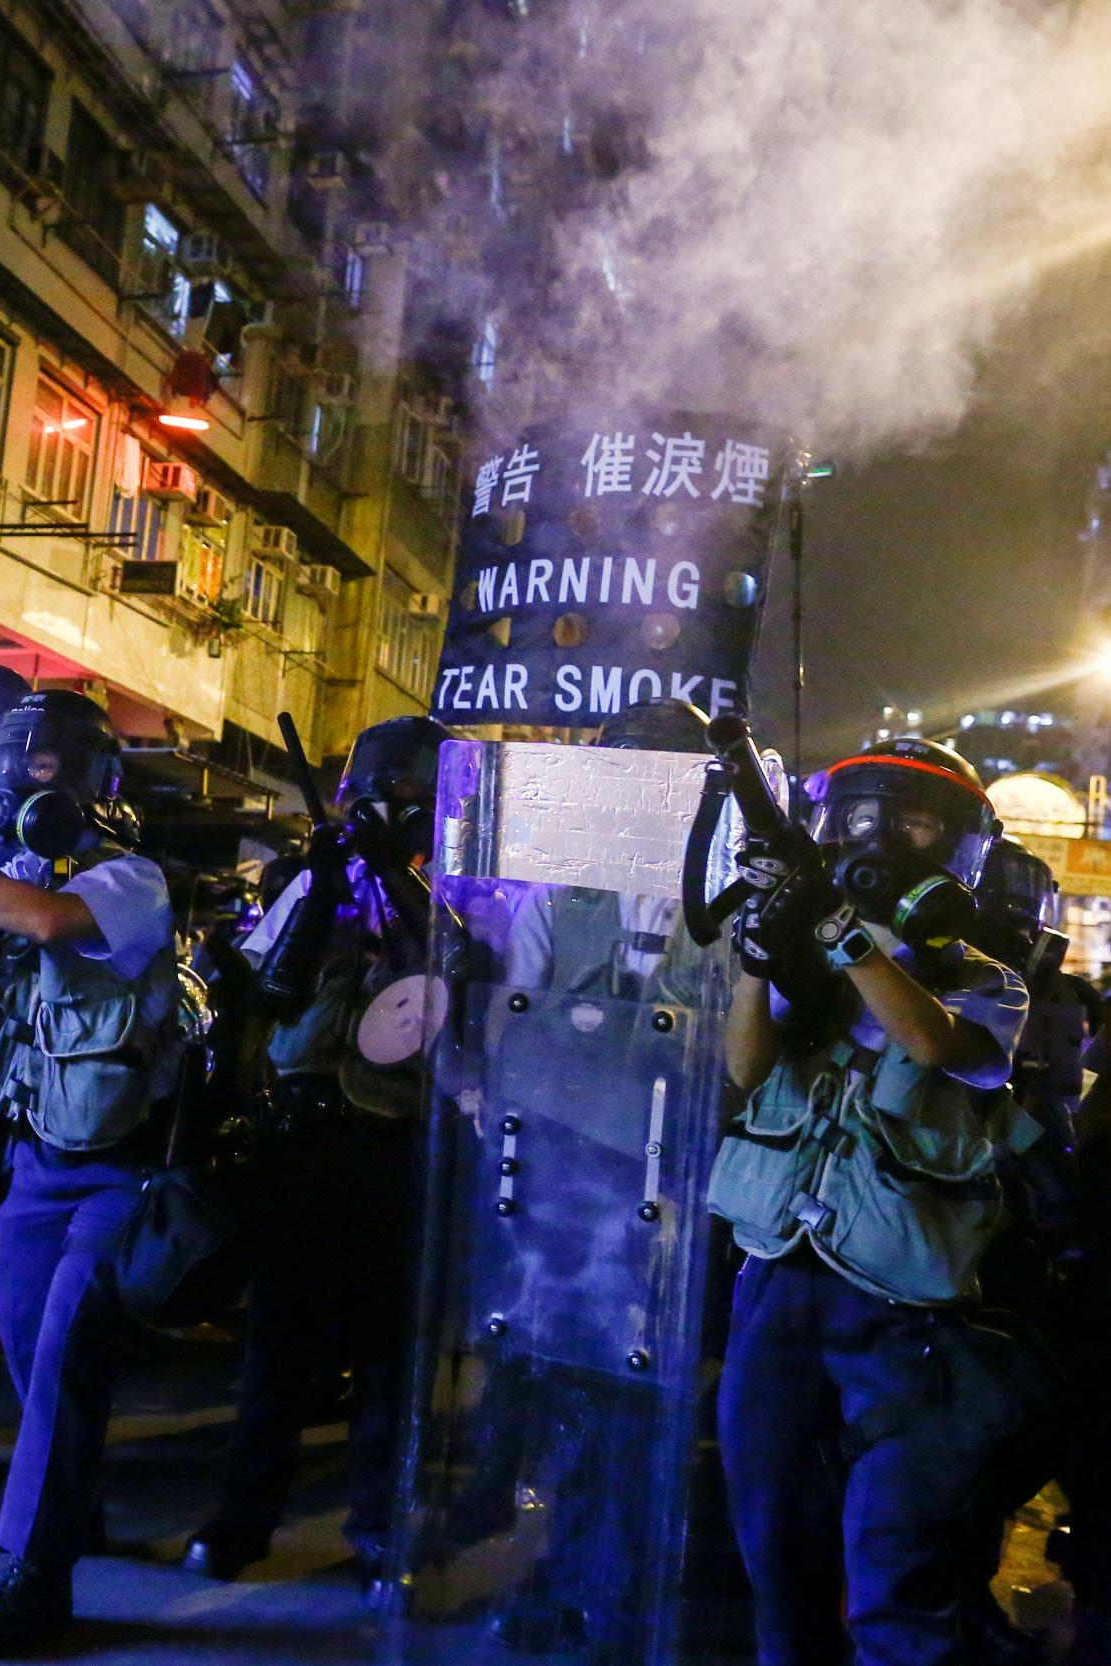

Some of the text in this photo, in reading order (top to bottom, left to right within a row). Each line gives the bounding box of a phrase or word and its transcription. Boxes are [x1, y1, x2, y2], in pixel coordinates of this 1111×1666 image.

[472, 431, 770, 518] 警告 催淚煙
[477, 557, 700, 612] WARNING
[437, 663, 738, 719] TEAR SMOKE
